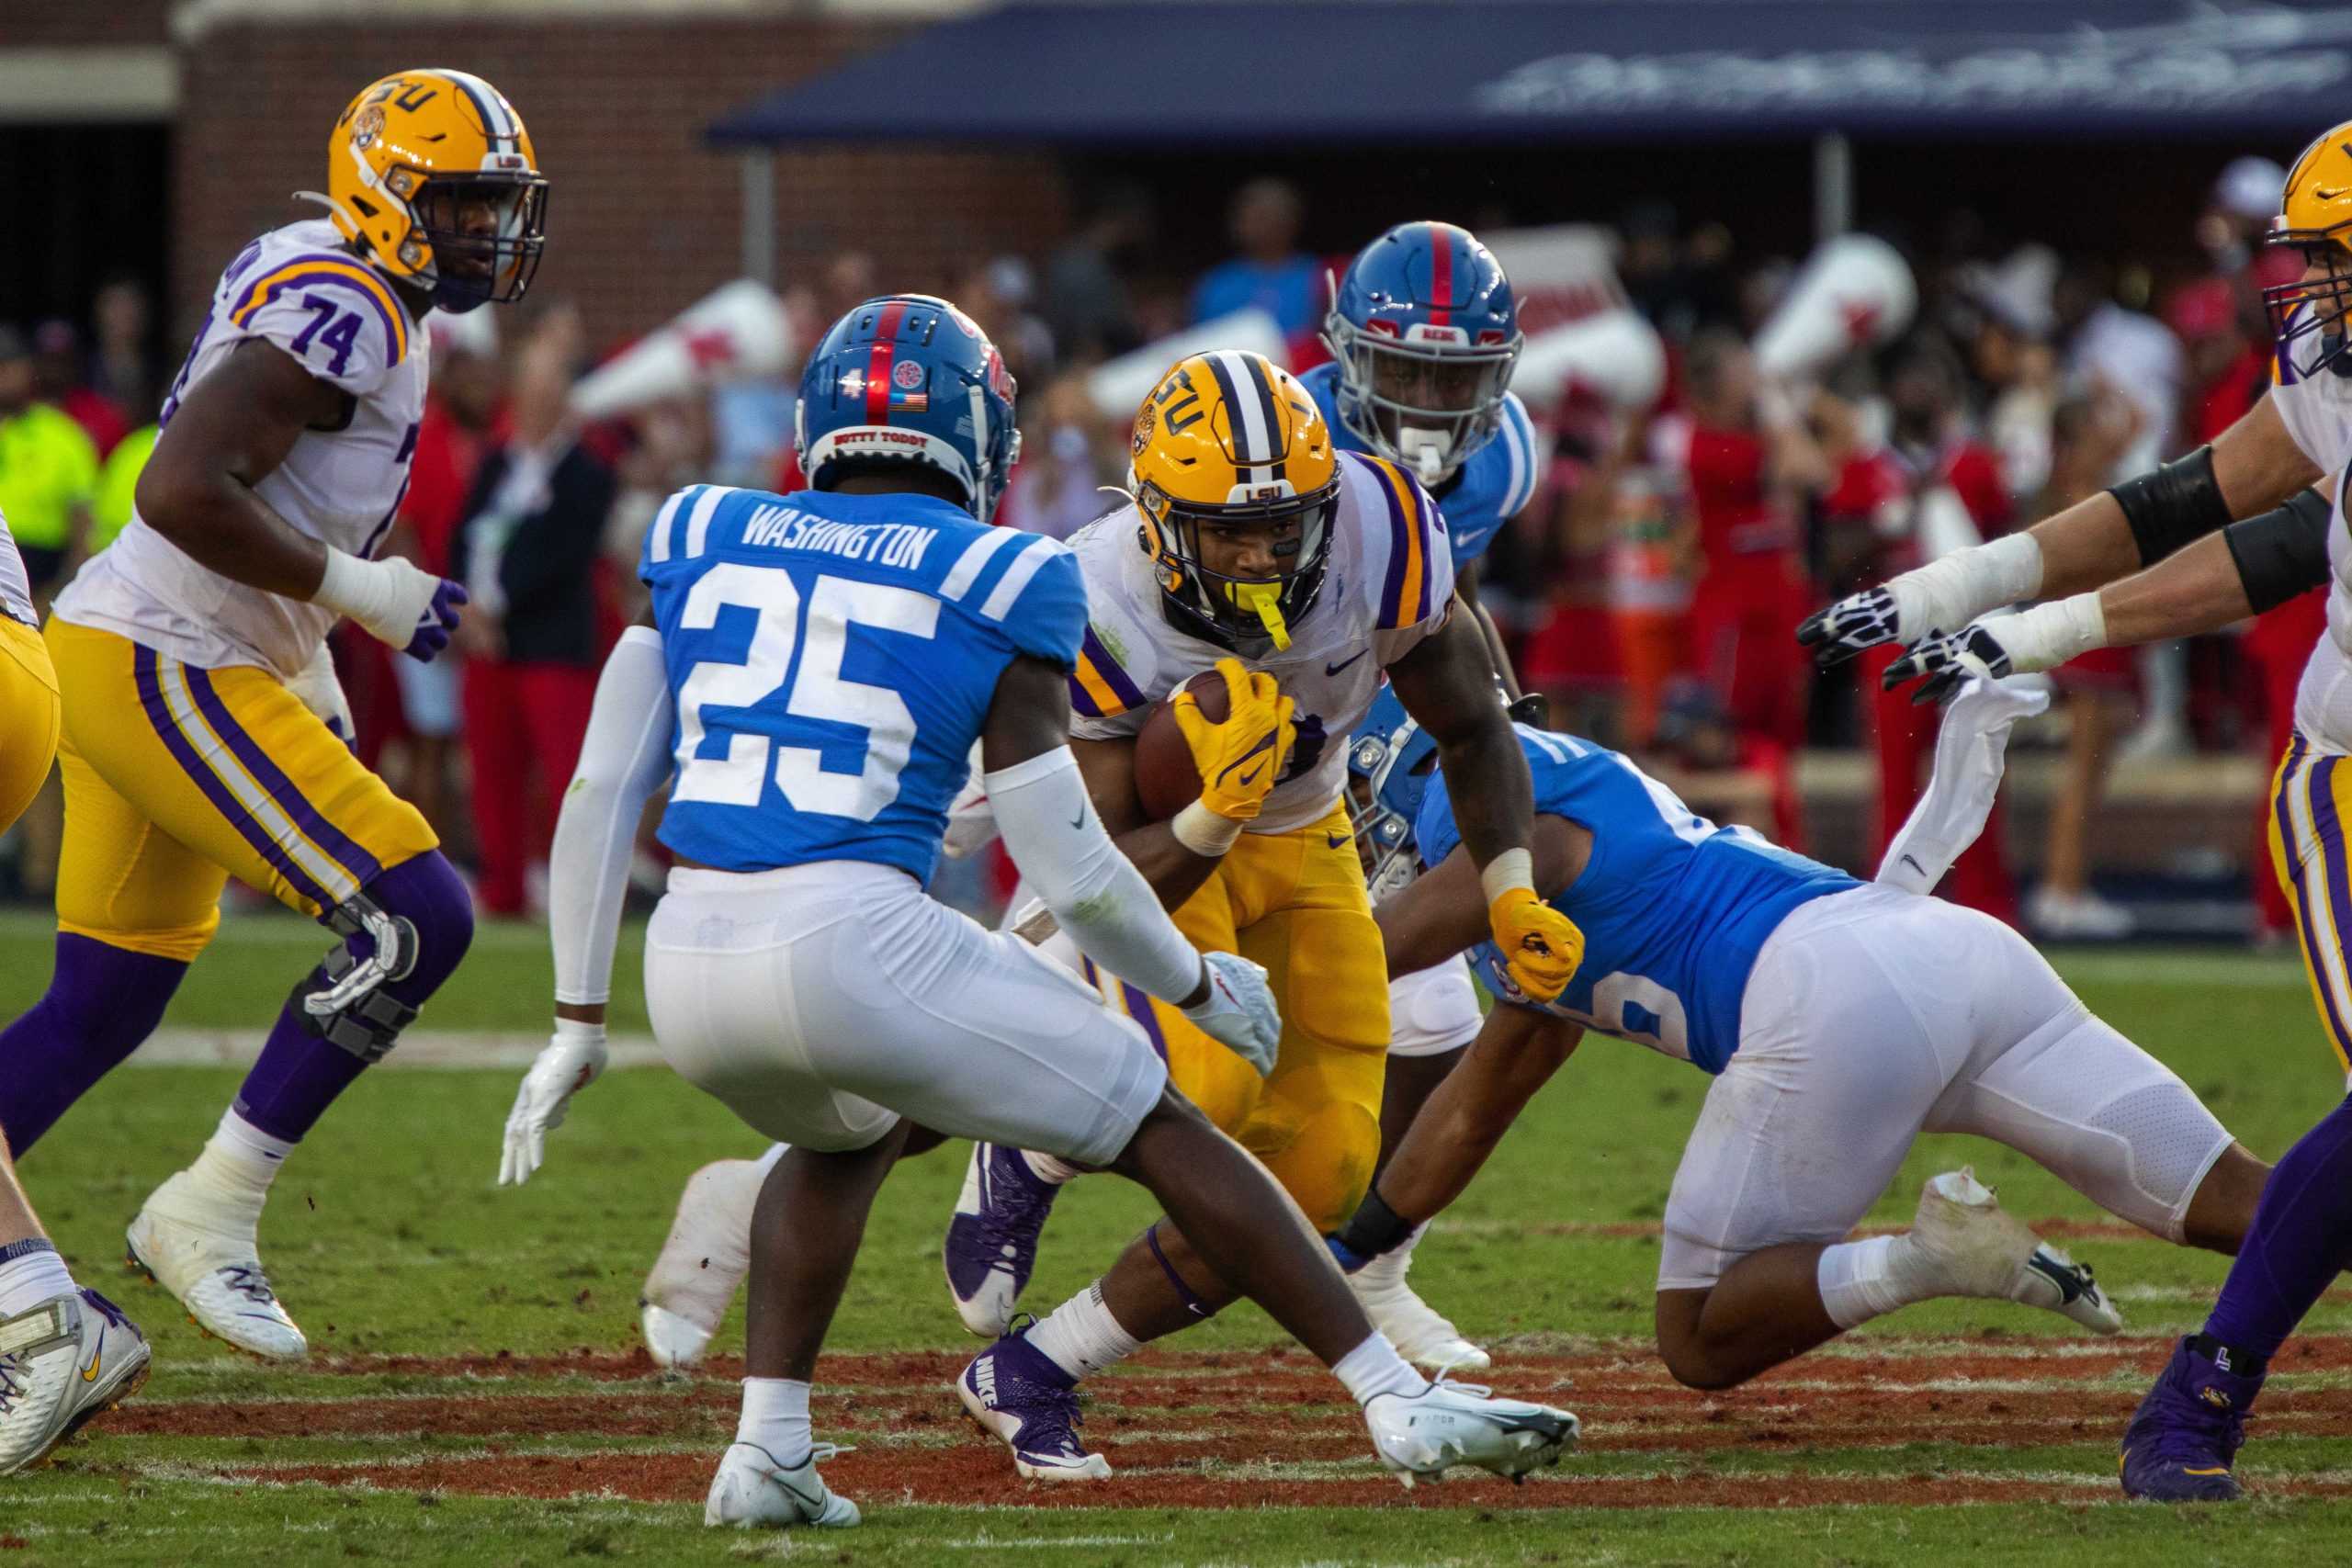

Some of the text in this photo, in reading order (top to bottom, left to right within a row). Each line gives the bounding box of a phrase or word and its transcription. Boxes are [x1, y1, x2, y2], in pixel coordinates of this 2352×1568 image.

[290, 293, 364, 377] 74
[1153, 369, 1205, 437] SU
[881, 432, 928, 447] TODDY
[1246, 486, 1283, 502] LSU
[741, 503, 938, 570] WASHINGTON
[669, 562, 942, 822] 25
[976, 1354, 999, 1411] NIKE
